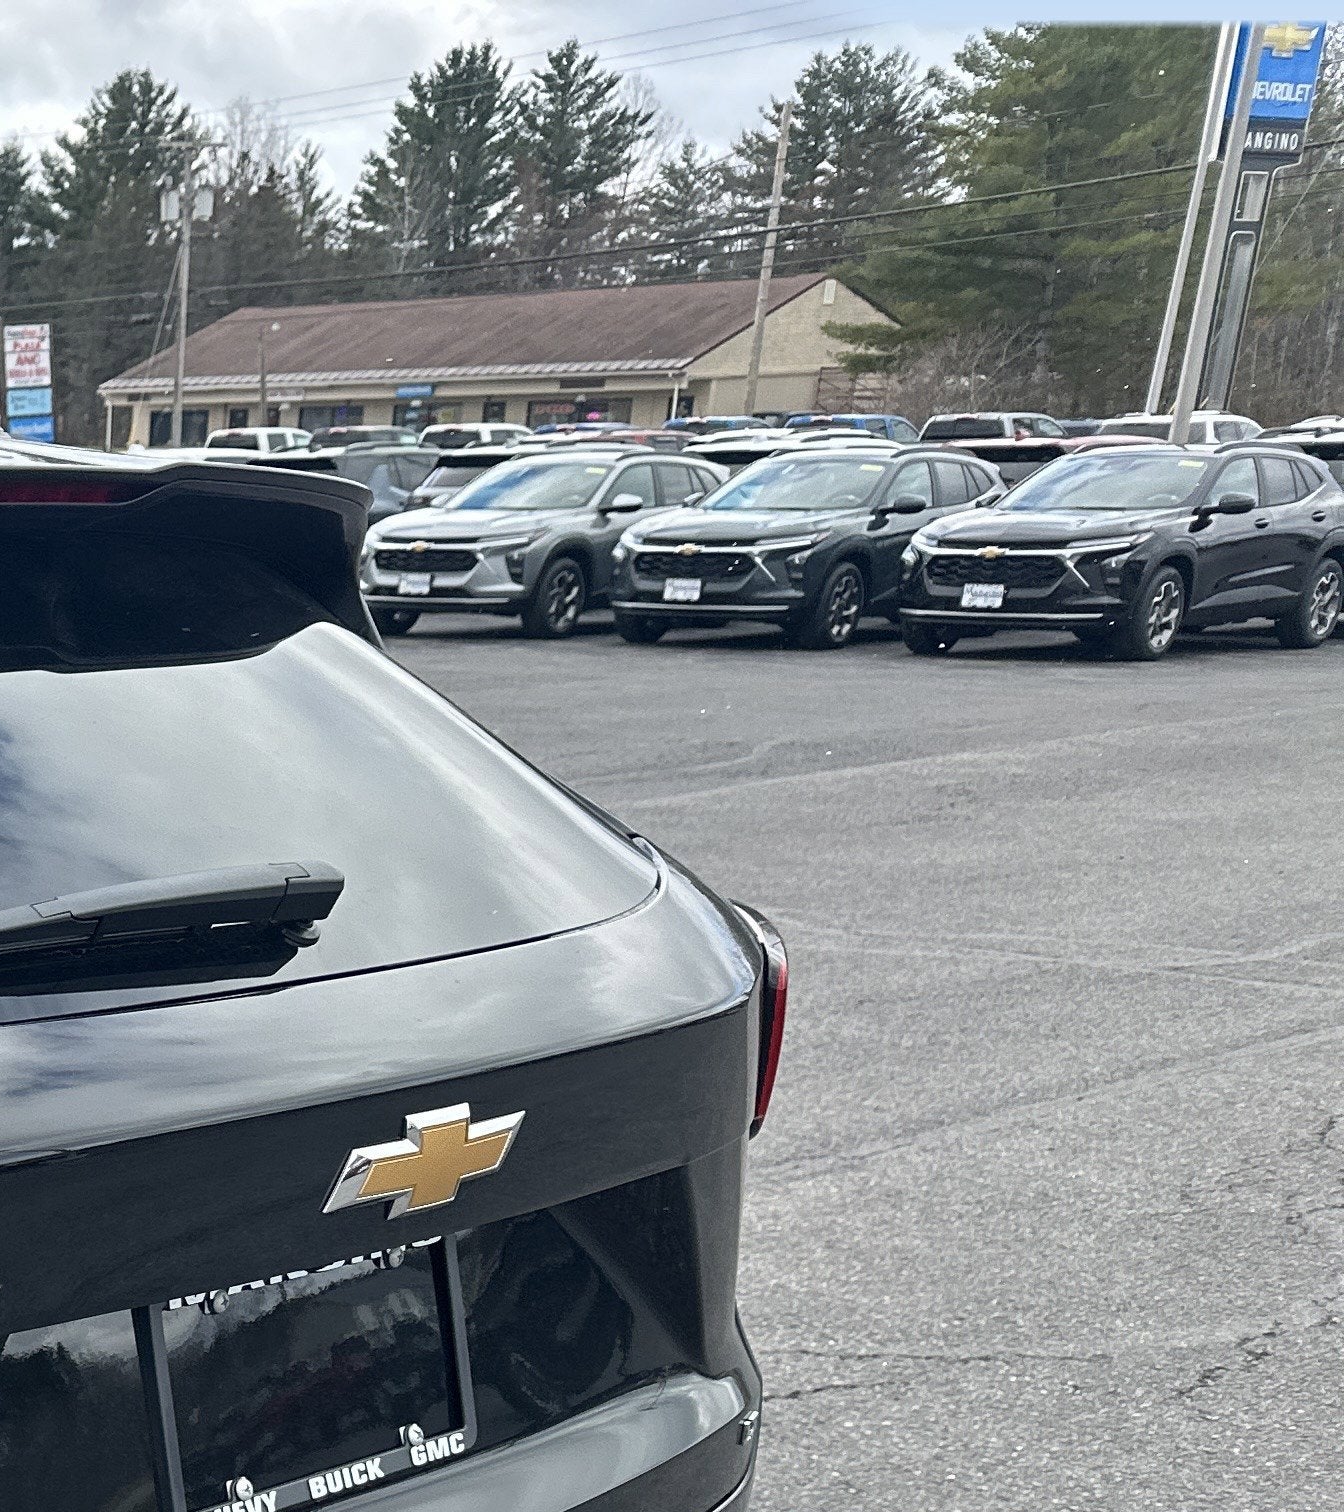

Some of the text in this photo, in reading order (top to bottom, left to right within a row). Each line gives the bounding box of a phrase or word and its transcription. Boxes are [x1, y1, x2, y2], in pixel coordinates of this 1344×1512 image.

[1252, 80, 1313, 102] EVROLET
[1244, 131, 1299, 151] ANGINO
[308, 1457, 385, 1500] BUICK
[410, 1432, 465, 1467] GMC
